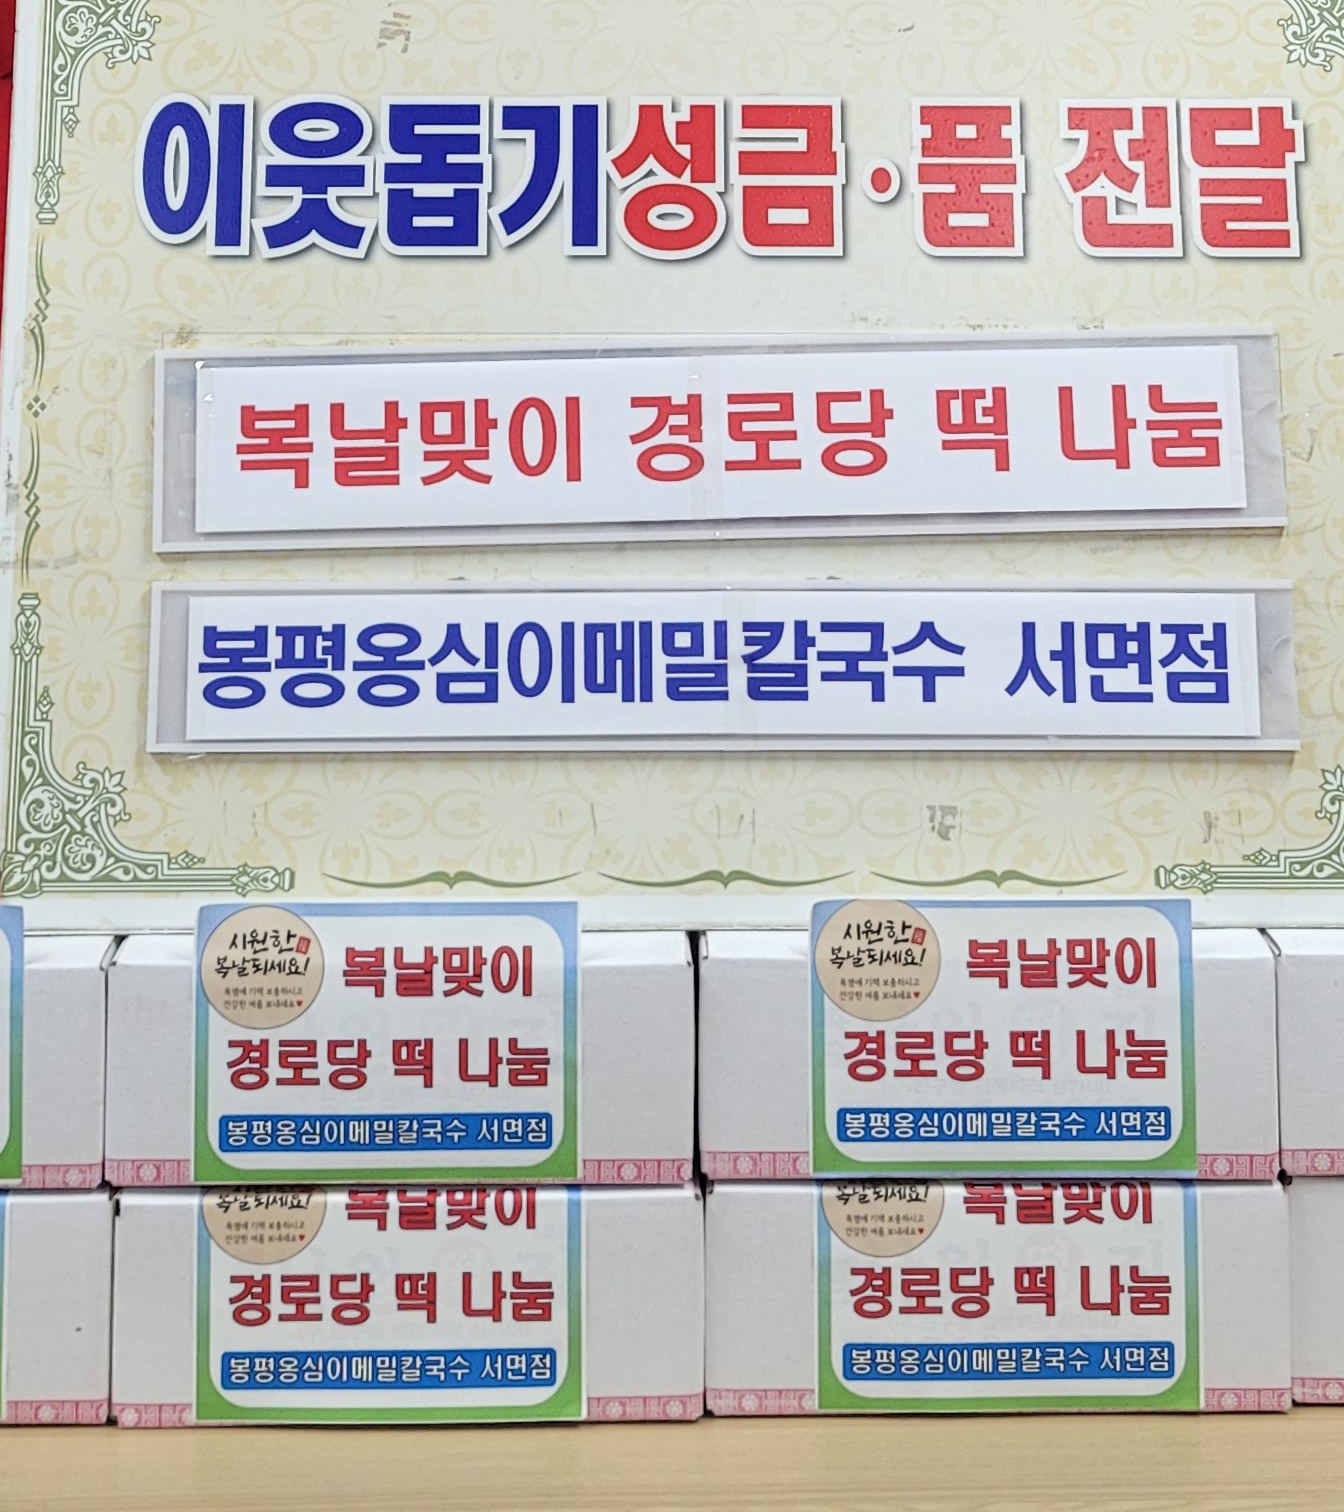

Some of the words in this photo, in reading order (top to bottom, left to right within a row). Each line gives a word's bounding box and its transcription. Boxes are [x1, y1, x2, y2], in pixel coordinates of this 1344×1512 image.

[1059, 96, 1304, 260] 전달
[236, 396, 581, 488] 복날맞이
[629, 389, 893, 482] 경로당
[936, 386, 1010, 471] 떡
[1058, 384, 1222, 469] 나눔
[198, 620, 965, 709] 봉평옹심이메밀칼국수
[1004, 621, 1229, 703] 서면점
[338, 942, 532, 1002] 복날맞이
[966, 934, 1156, 993] 복날맞이
[227, 1038, 371, 1090] 경로당
[392, 1038, 433, 1088] 떡
[458, 1037, 550, 1087] 나눔
[844, 1030, 988, 1081] 경로당
[1009, 1030, 1050, 1080] 떡
[1076, 1029, 1168, 1079] 나눔
[228, 1119, 466, 1145] 봉평옹심이메밀칼국수
[478, 1113, 552, 1142] 서면점
[845, 1112, 1085, 1137] 봉평옹심이메밀칼국수
[1096, 1108, 1172, 1141] 서면점
